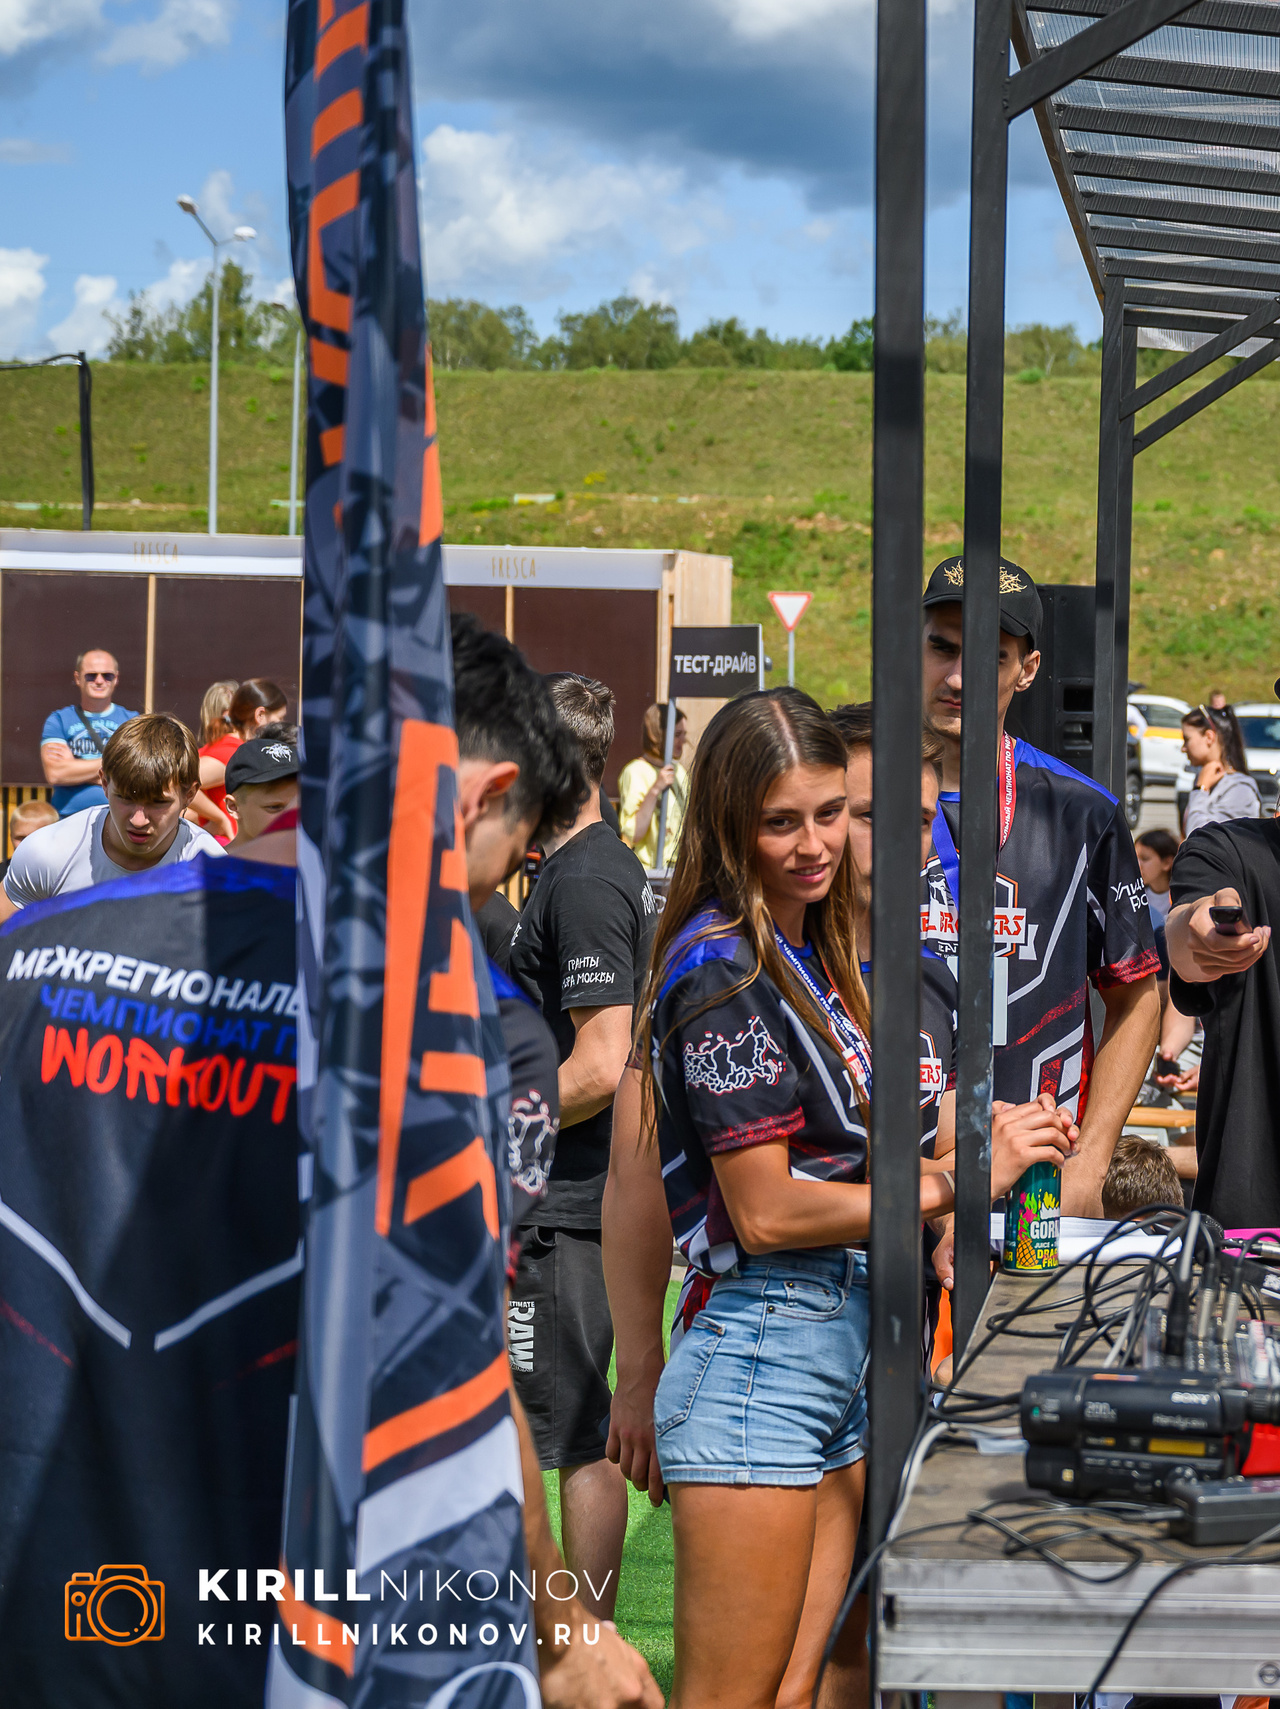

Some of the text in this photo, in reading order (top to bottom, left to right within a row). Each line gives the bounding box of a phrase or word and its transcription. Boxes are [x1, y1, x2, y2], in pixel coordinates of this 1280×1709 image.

[133, 542, 178, 564] FRESCA
[491, 557, 536, 579] FRESCA
[674, 651, 757, 676] ТЕСТ-ДРАЙВ
[1004, 762, 1013, 806] ЧЕМПИОНАТ
[567, 956, 600, 972] ГРАНТЫ
[783, 943, 822, 997] ЧЕМПИОНАТ
[576, 972, 616, 985] МОСКВЫ
[40, 983, 272, 1051] ЧЕМПИОНАТ
[40, 1024, 298, 1125] WORKOUT
